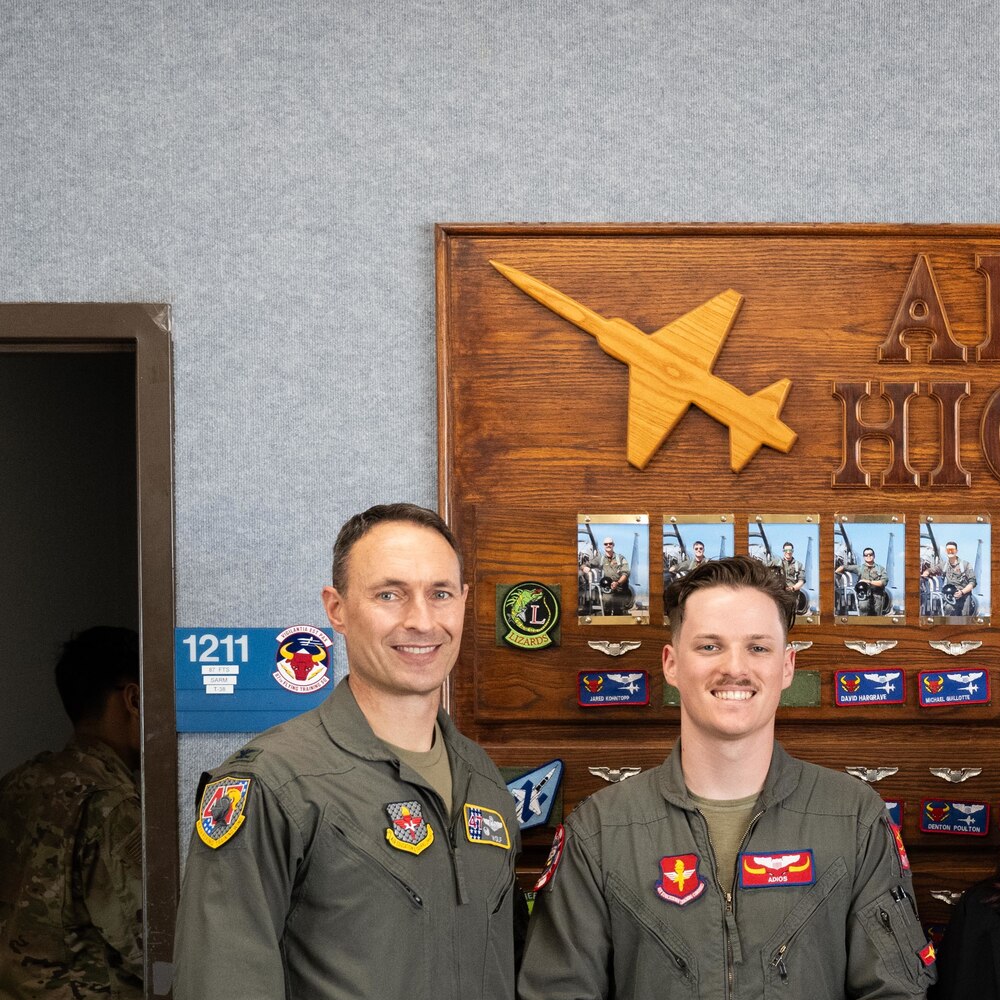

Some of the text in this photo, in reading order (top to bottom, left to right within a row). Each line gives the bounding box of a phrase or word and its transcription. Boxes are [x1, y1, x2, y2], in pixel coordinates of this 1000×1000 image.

[508, 632, 549, 647] LIZARDS
[182, 634, 249, 663] 1211
[840, 694, 887, 702] DAVID HARGRAVE
[926, 696, 946, 704] MICHAEL
[928, 823, 981, 832] DENTON POULTON
[768, 875, 788, 883] ADIOS
